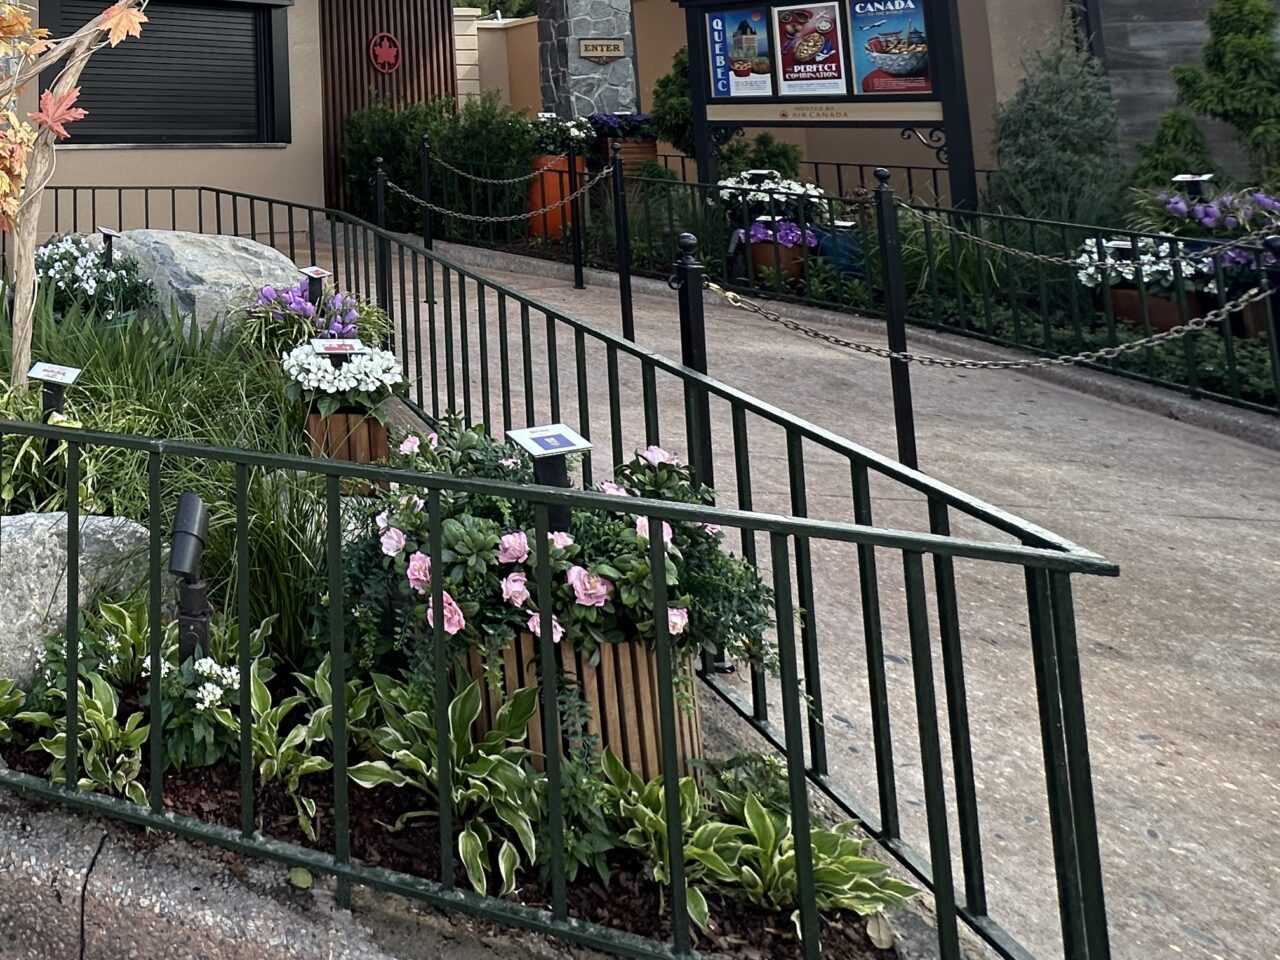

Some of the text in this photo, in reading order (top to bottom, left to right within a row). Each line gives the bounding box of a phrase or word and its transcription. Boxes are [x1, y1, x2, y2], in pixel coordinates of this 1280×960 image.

[854, 0, 916, 13] CANADA
[583, 44, 621, 52] ENTER
[712, 19, 728, 91] QUEBEC
[793, 63, 837, 73] PERFECT
[785, 71, 838, 79] COMBINATION
